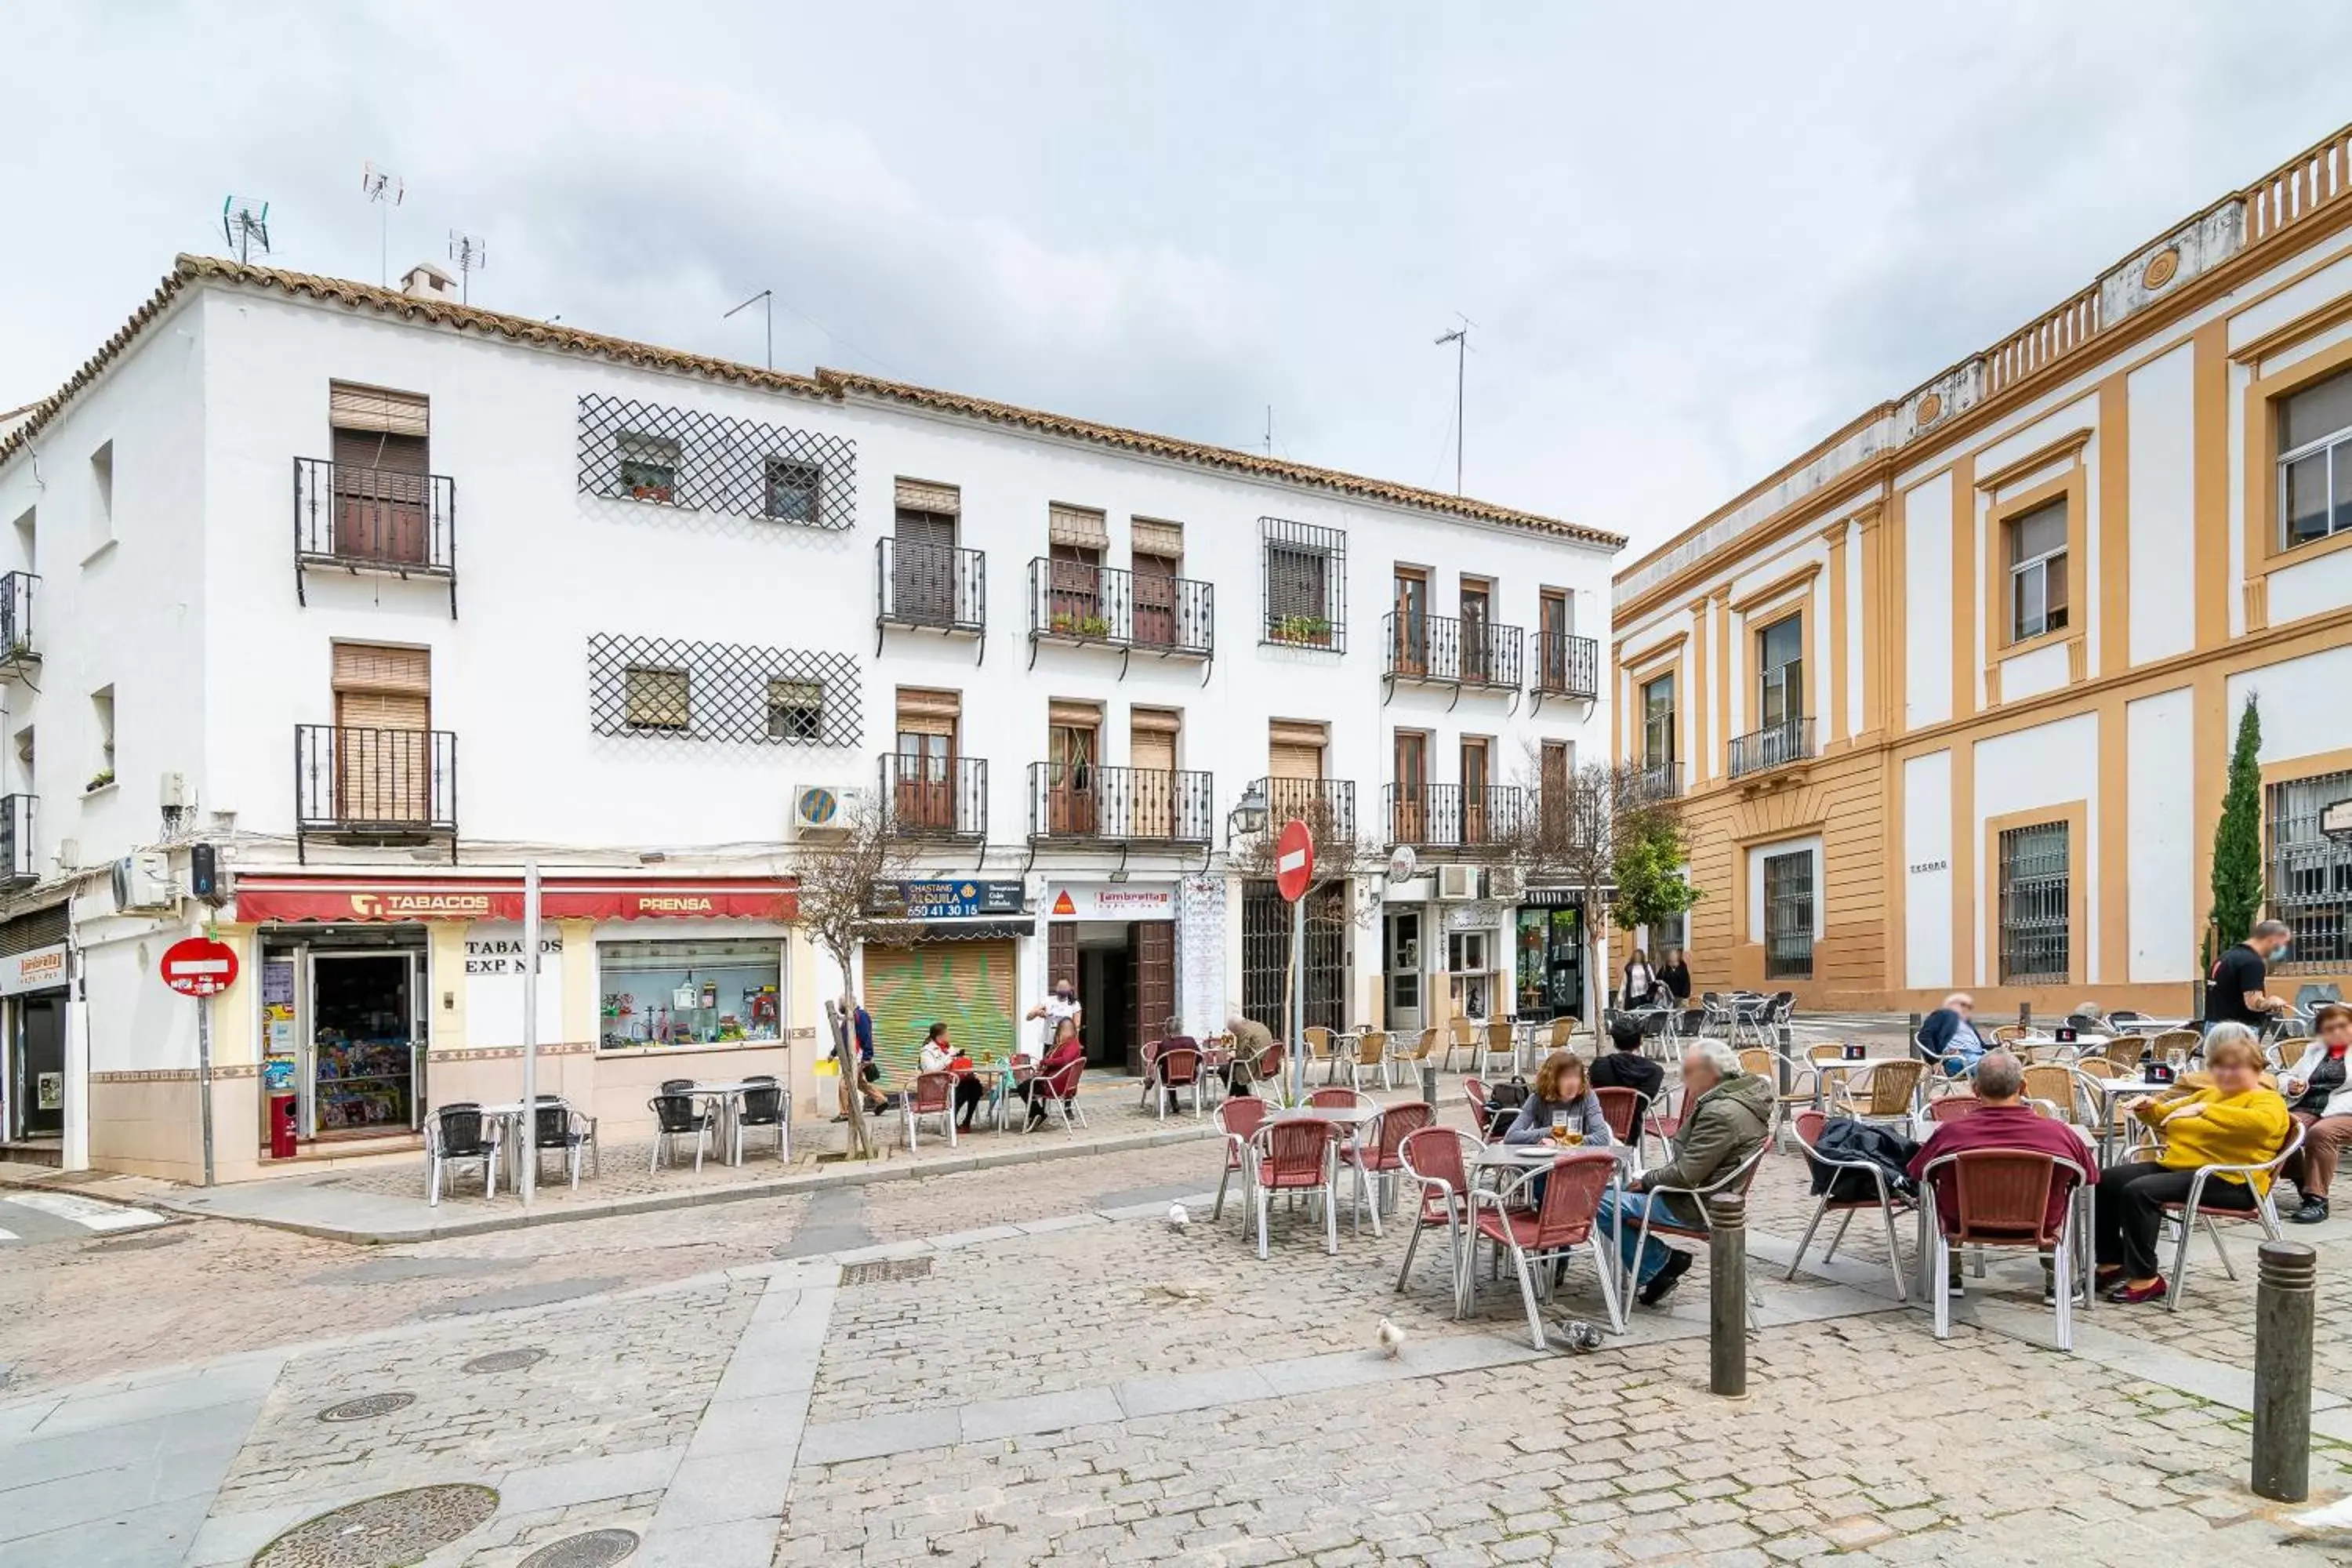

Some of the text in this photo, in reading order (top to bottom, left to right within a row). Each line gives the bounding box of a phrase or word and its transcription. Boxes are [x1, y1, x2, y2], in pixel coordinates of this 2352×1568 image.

[387, 896, 488, 909] TABACOS
[639, 898, 713, 910] PRENSA
[909, 893, 960, 904] ALQUILA
[907, 905, 928, 916] 650
[931, 905, 944, 916] 41
[947, 904, 961, 916] 30
[465, 940, 563, 954] TABAOS
